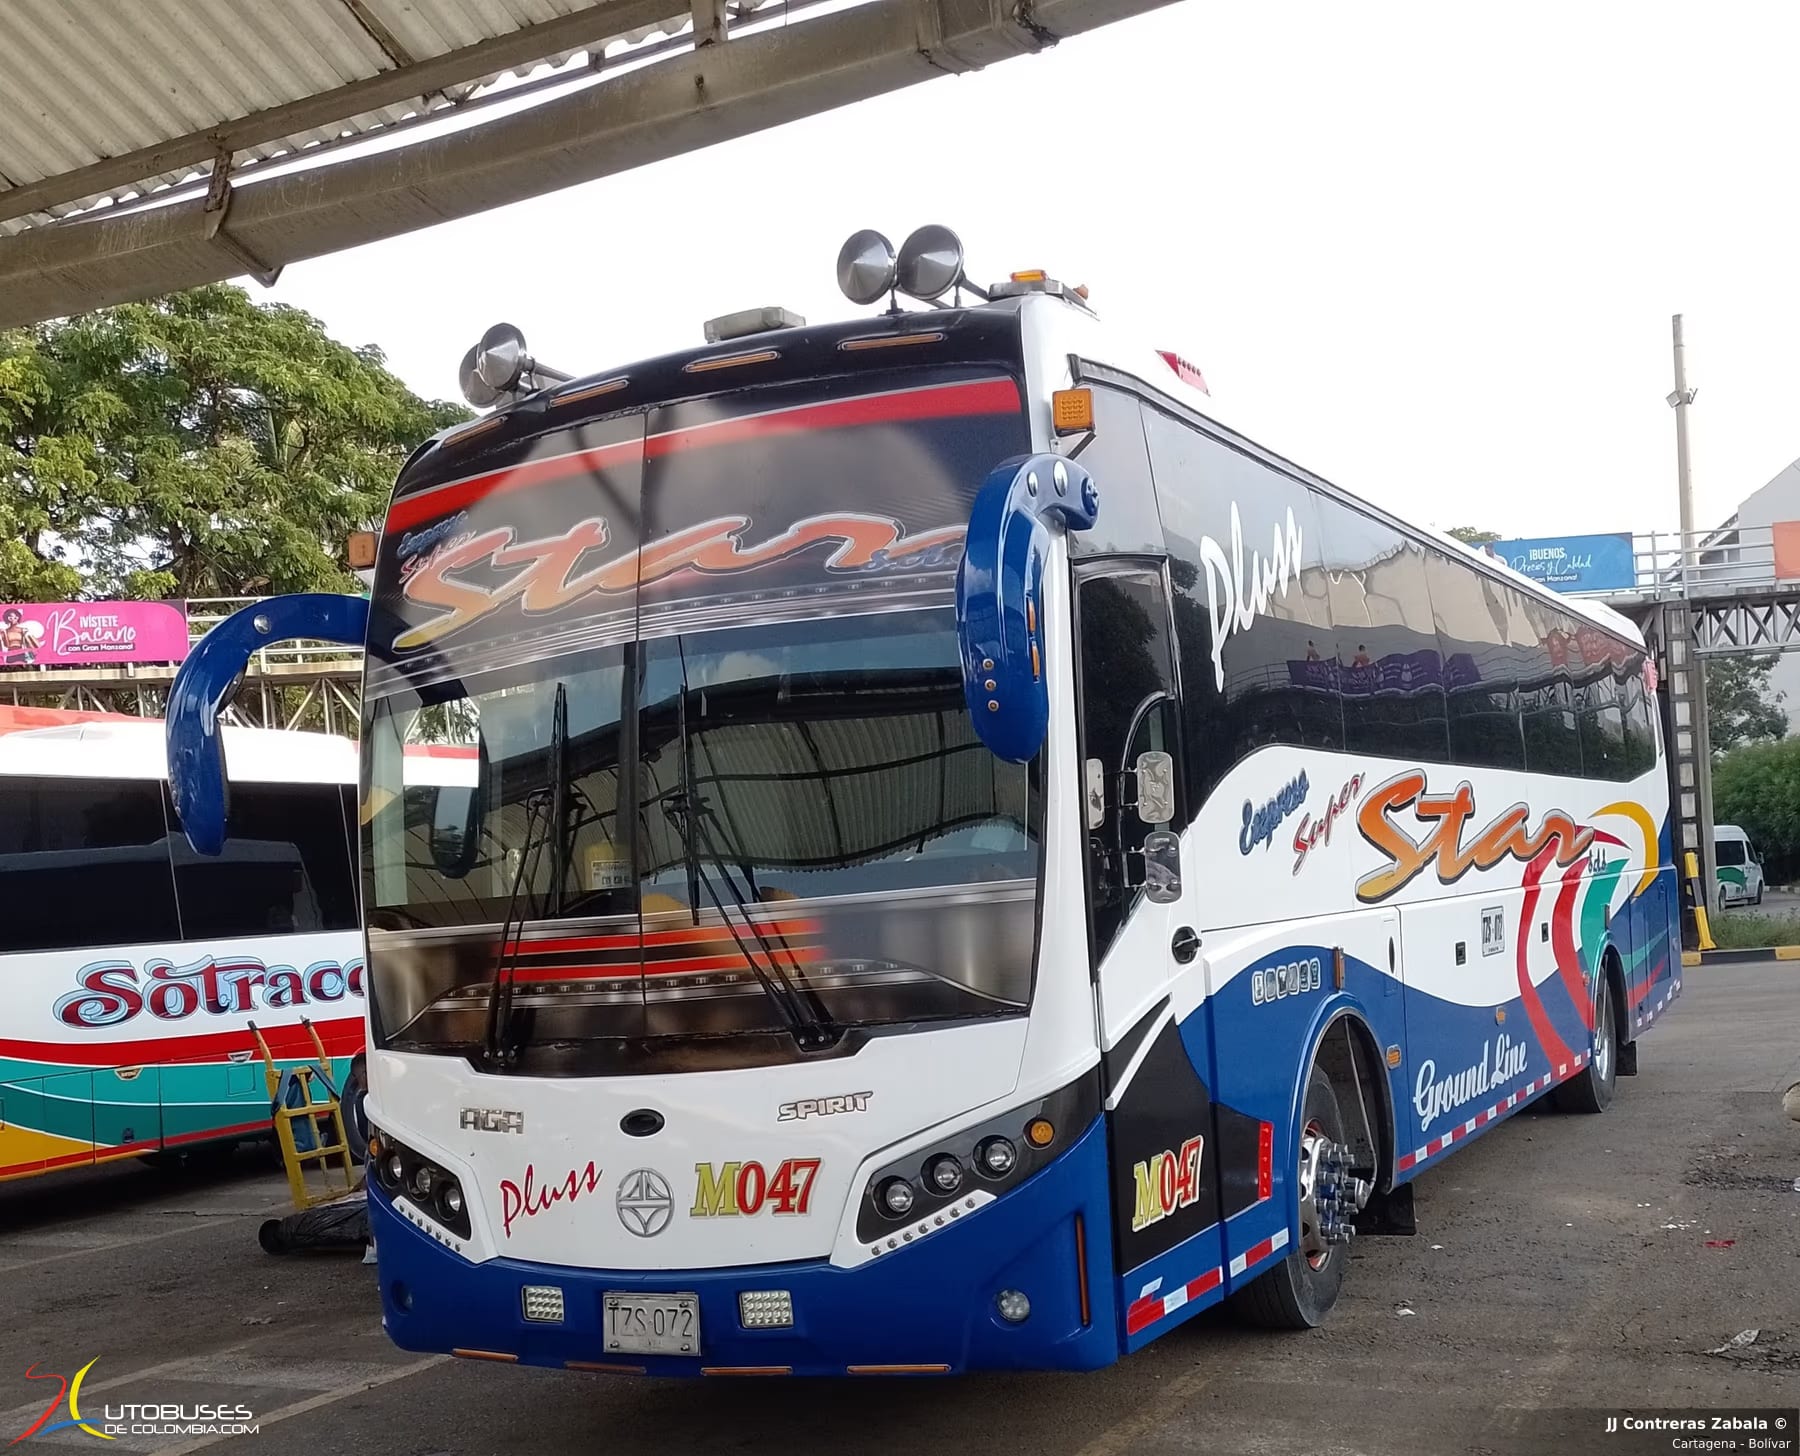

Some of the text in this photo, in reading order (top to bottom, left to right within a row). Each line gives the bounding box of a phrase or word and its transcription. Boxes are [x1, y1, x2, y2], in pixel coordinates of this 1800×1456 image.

[1355, 768, 1595, 904] Star
[777, 1091, 874, 1122] SPIRIT
[1413, 1033, 1528, 1132] Ground Line
[500, 1160, 603, 1239] Pluss
[690, 1157, 822, 1220] M047
[1132, 1135, 1204, 1232] M047
